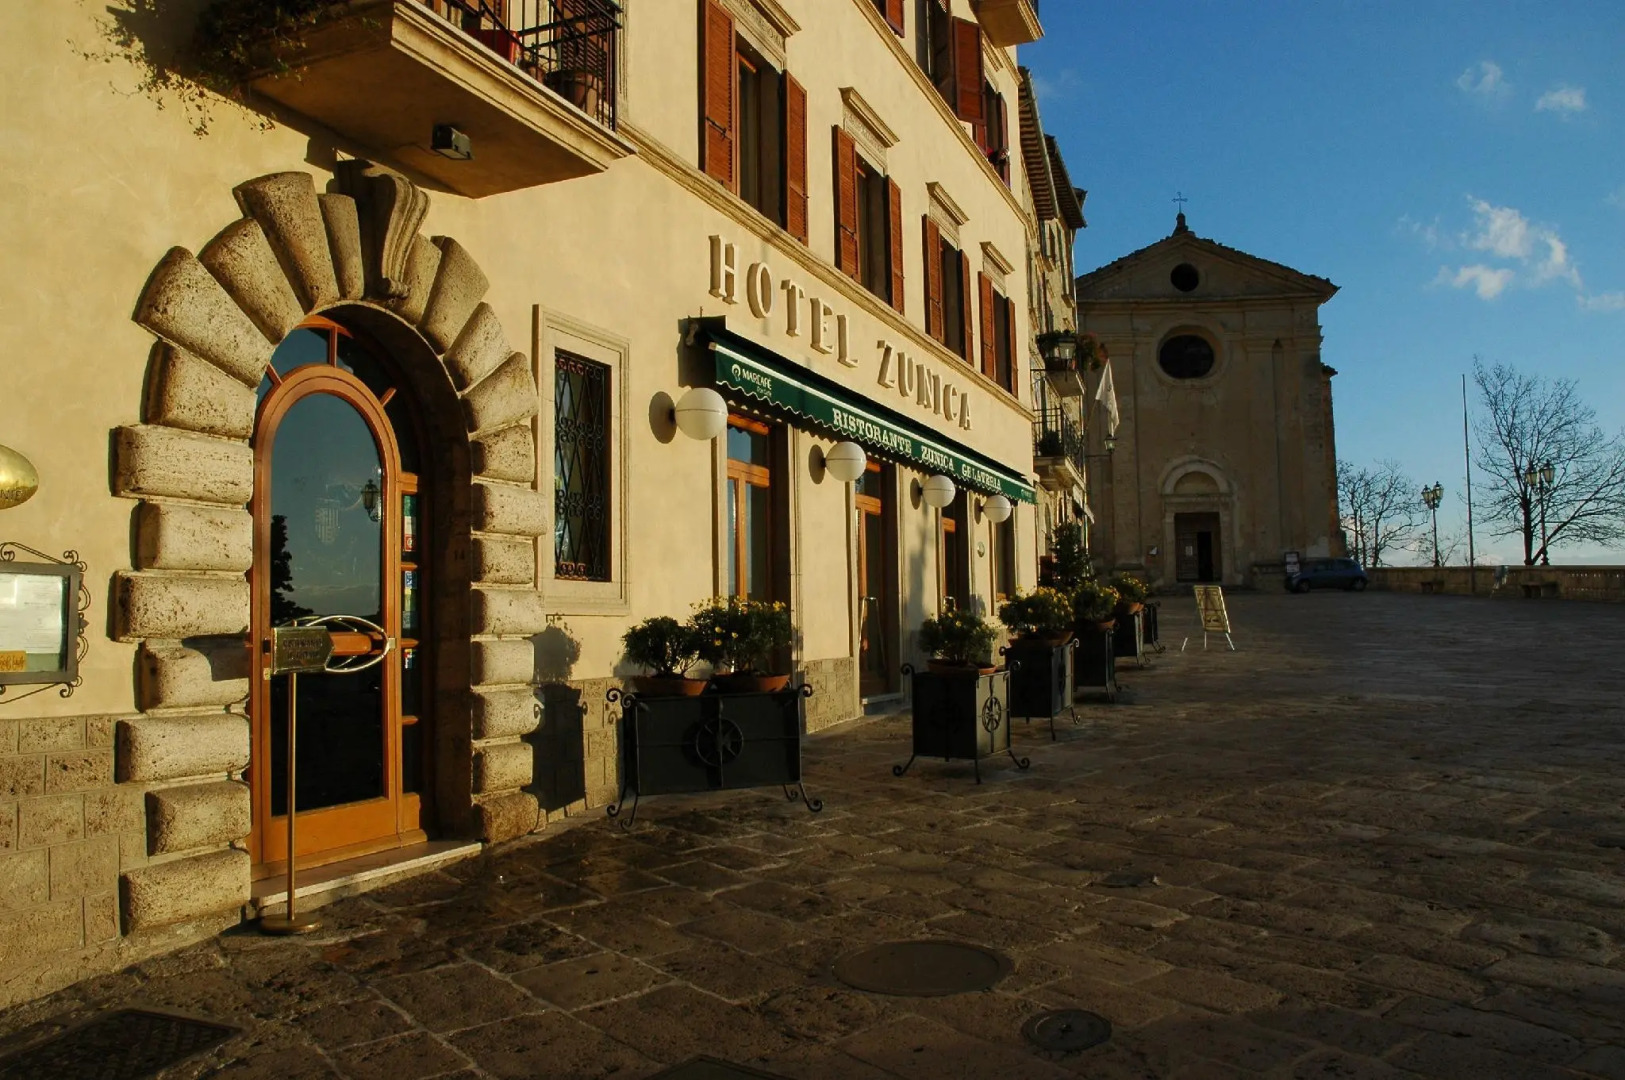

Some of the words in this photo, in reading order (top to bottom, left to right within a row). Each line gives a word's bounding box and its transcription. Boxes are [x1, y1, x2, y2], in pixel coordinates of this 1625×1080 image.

[708, 234, 859, 369] HOTEL
[876, 339, 972, 431] ZUNICA
[832, 407, 912, 456] RISTORANTE
[921, 445, 954, 471] ZUNICA
